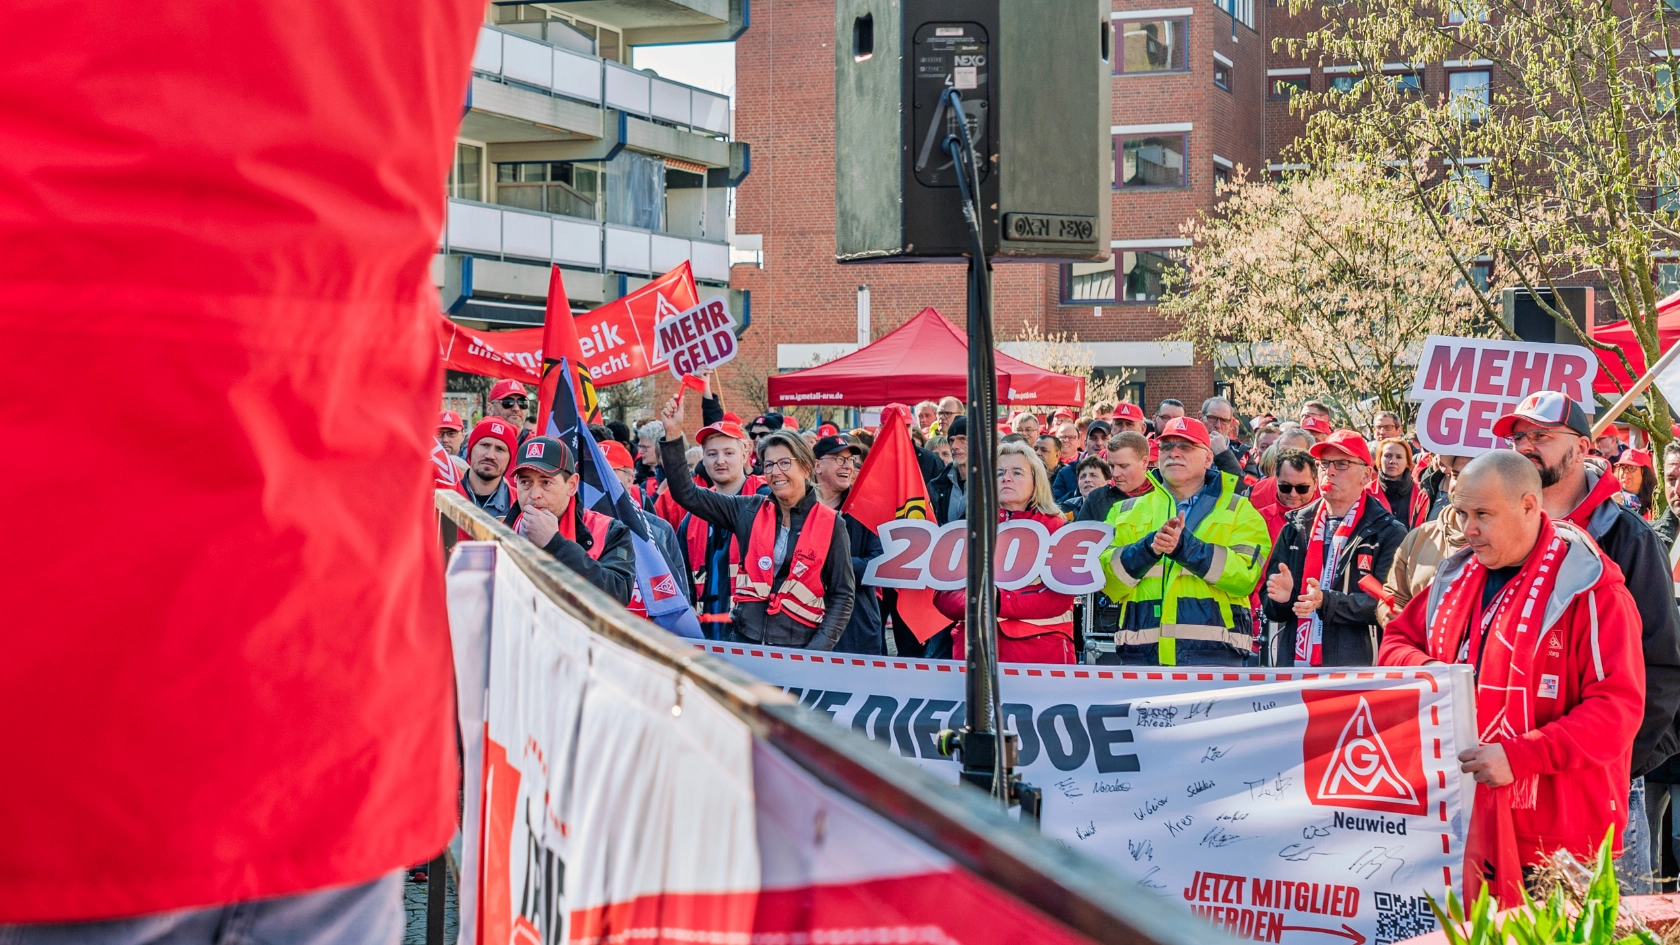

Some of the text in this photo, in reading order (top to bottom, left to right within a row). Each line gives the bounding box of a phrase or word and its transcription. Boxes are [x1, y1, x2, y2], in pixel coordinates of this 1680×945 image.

[954, 55, 987, 67] NEXO
[659, 300, 729, 354] MEHR
[673, 330, 733, 376] GELD
[1423, 345, 1588, 402] MEHR
[875, 526, 1107, 586] 200€
[1334, 811, 1407, 836] Neuwied
[1183, 870, 1247, 905] JETZT
[1251, 877, 1361, 919] MITGLIED
